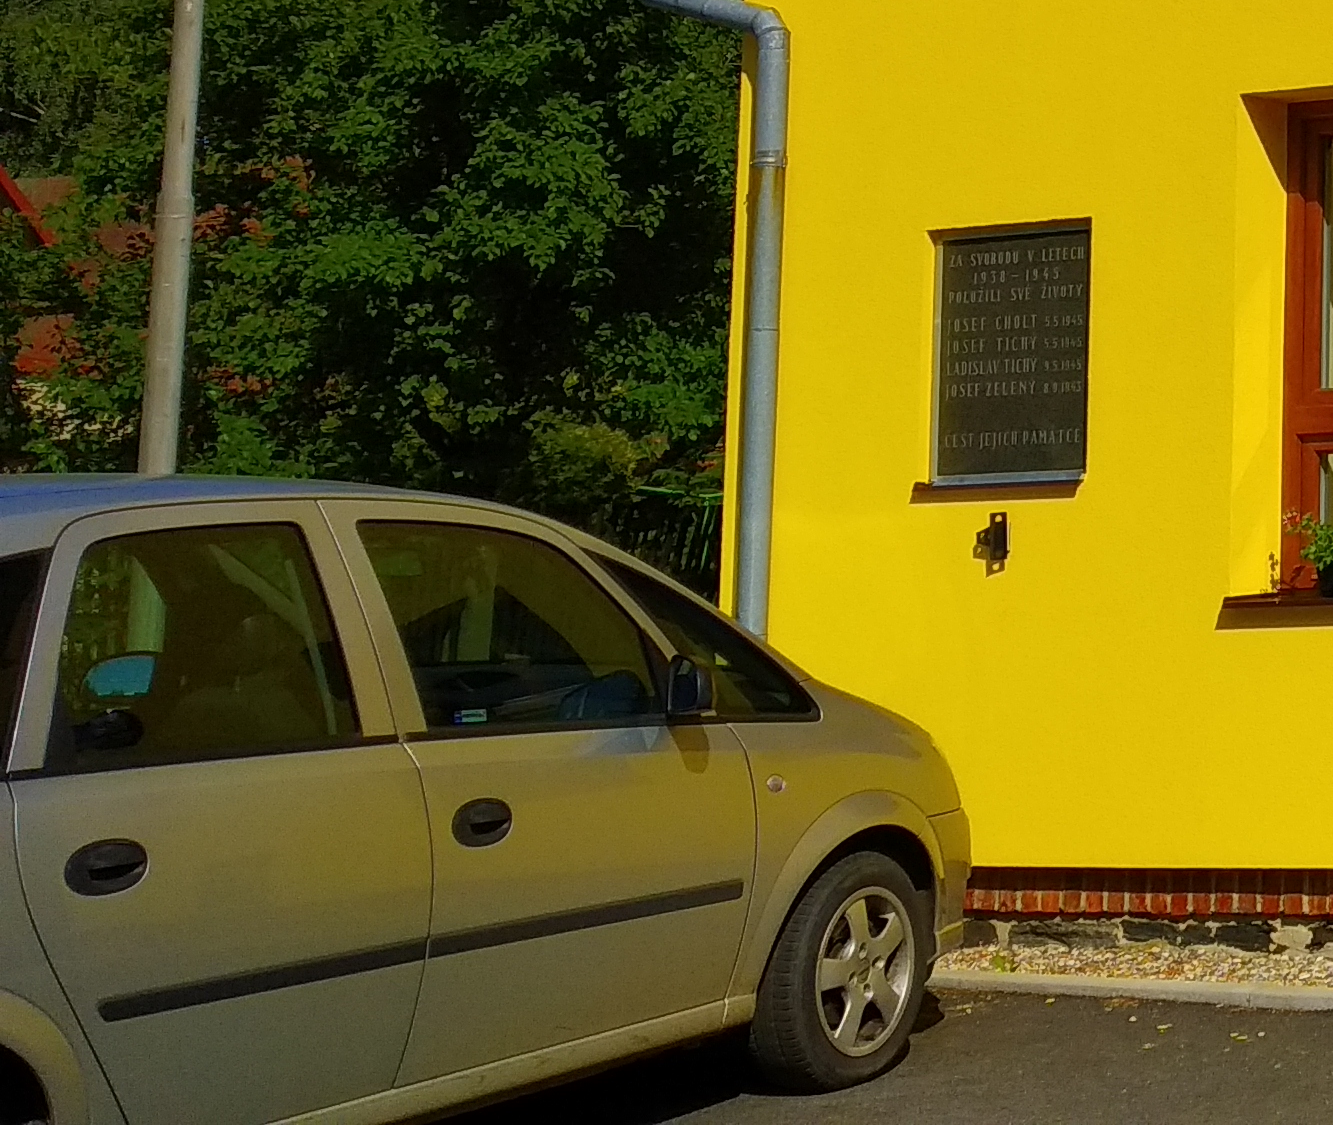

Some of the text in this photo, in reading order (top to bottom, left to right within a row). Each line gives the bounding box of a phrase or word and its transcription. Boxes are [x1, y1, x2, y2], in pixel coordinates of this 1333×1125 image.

[950, 246, 1085, 267] ZA SVOBODU V LETECH
[973, 270, 1006, 285] 1938
[1025, 267, 1060, 282] 1945
[1010, 283, 1031, 301] SVÉ
[1041, 283, 1083, 299] ŽIVOTY
[947, 317, 987, 335] JOSEF
[995, 314, 1038, 331] CHOLT
[947, 339, 986, 356] JOSEF
[946, 360, 1000, 376] LADISLAV
[945, 383, 981, 401] JOSEF
